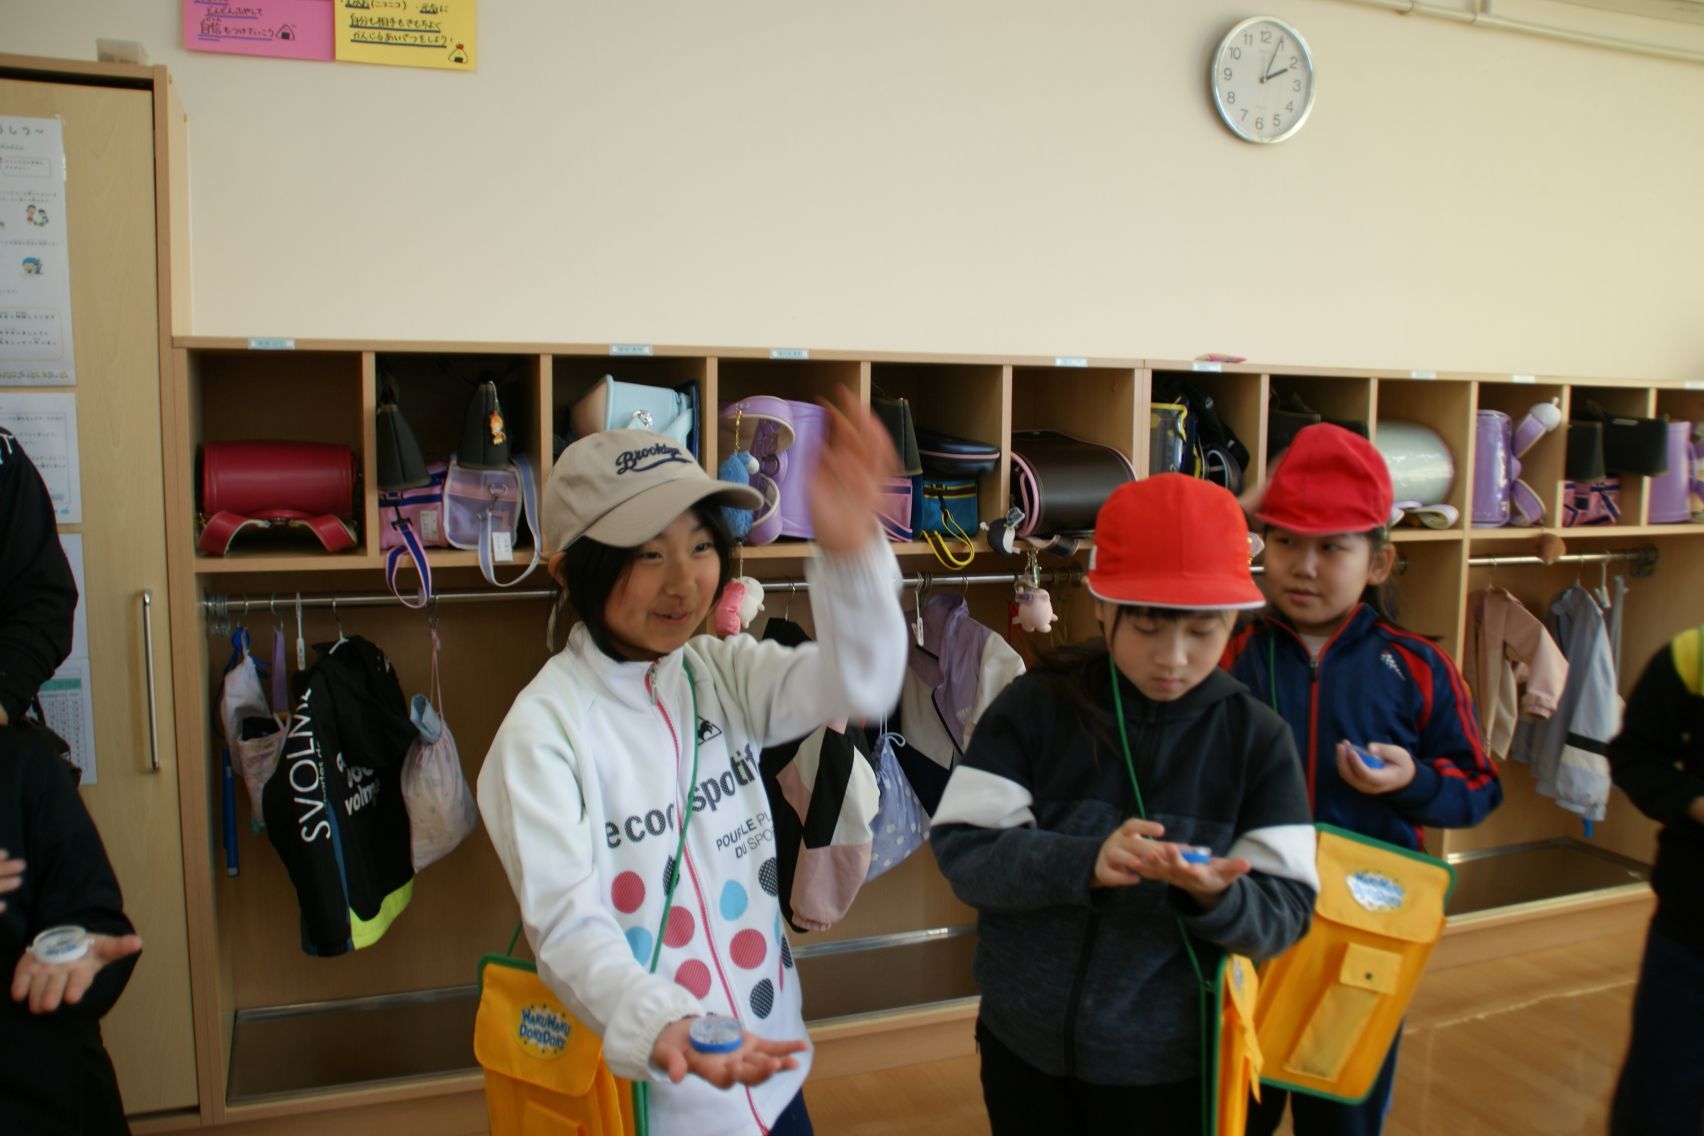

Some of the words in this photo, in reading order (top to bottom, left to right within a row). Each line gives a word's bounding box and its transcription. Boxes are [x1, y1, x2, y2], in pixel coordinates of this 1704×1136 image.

[1243, 33, 1253, 47] 11
[1259, 30, 1273, 44] 12
[1229, 46, 1242, 60] 10
[1289, 56, 1298, 70] 2
[1223, 67, 1233, 81] 9
[1292, 79, 1302, 93] 3
[1226, 91, 1236, 105] 8
[1285, 101, 1294, 113] 4
[1240, 108, 1249, 121] 7
[1272, 114, 1281, 127] 5
[1255, 117, 1264, 130] 6
[747, 826, 775, 850] SPO
